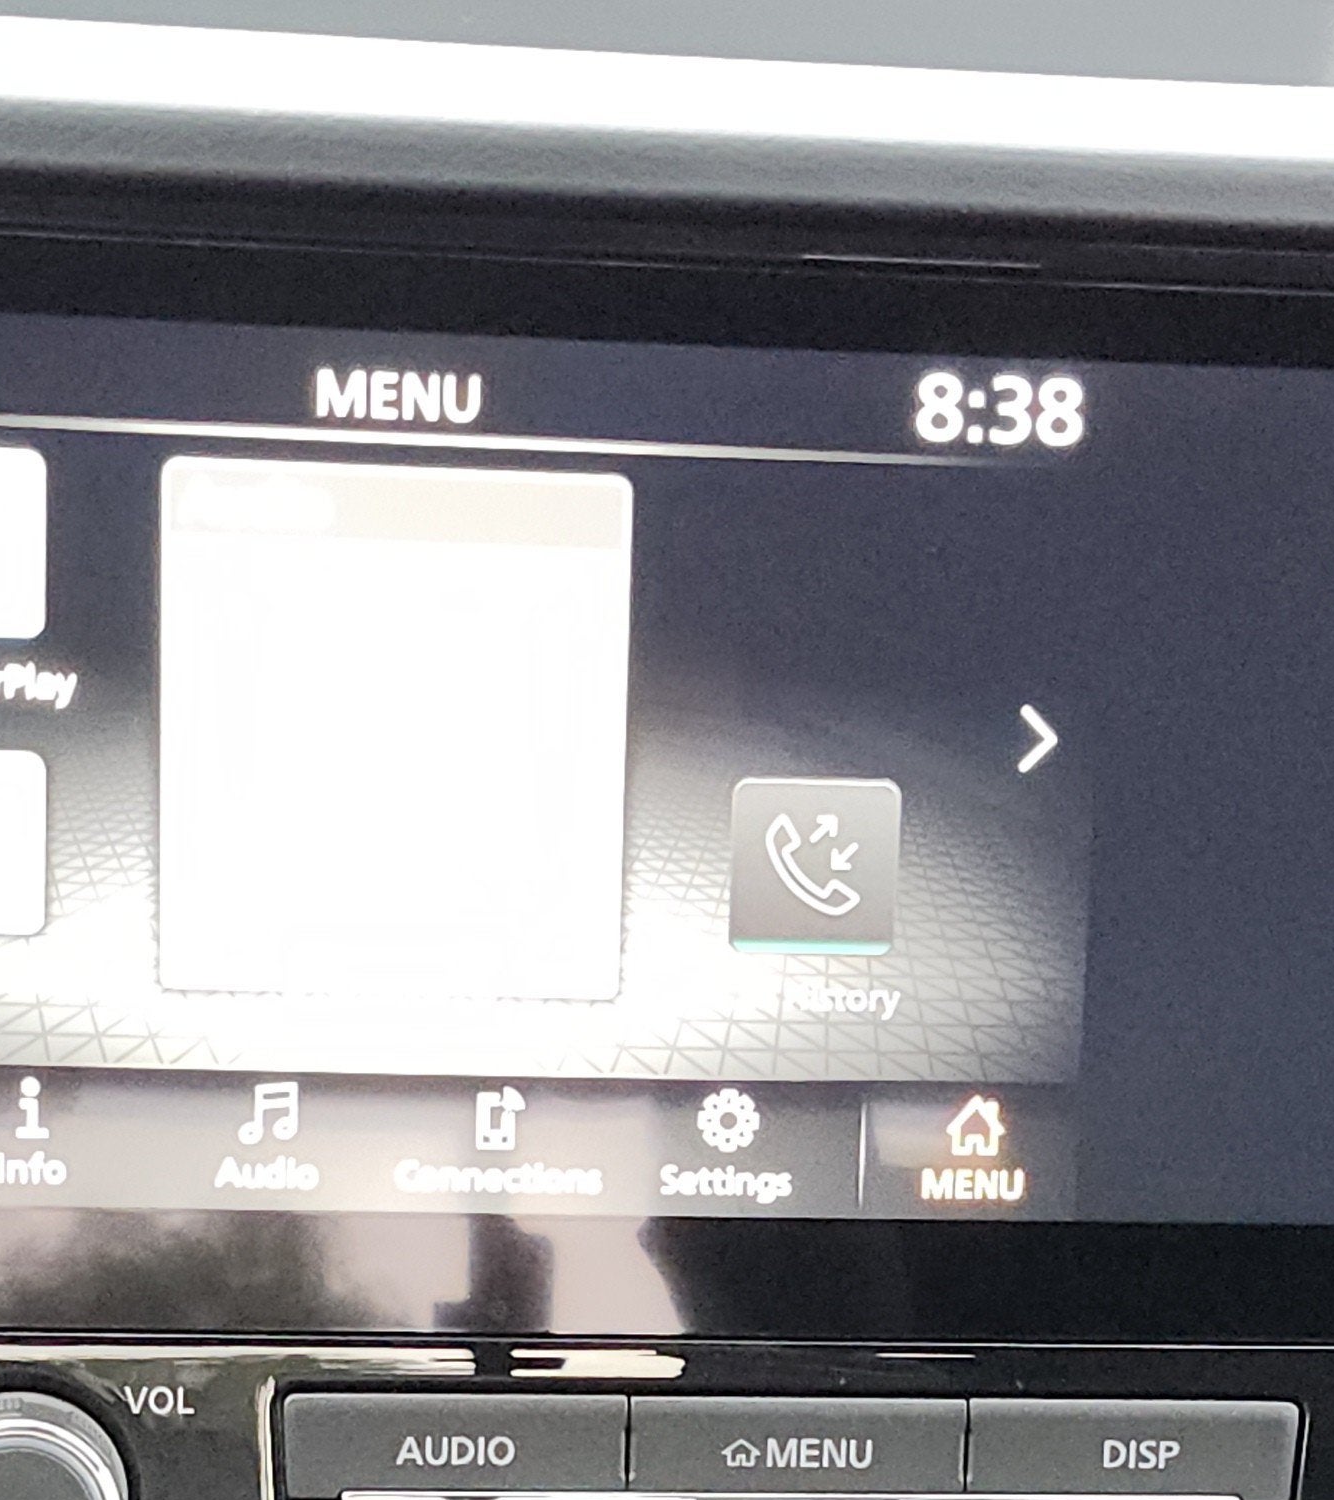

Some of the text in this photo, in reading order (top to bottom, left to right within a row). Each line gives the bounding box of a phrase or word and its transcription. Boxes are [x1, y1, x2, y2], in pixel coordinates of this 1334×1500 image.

[315, 368, 483, 424] MENU
[916, 372, 1085, 448] 8:38
[215, 1156, 320, 1191] Audio
[393, 1160, 603, 1196] Connections
[661, 1165, 793, 1205] Settings
[922, 1169, 1025, 1201] MENU
[125, 1386, 196, 1416] VOL
[396, 1436, 517, 1468] AUDIO
[767, 1438, 874, 1470] MENU
[1104, 1440, 1182, 1470] DISP
